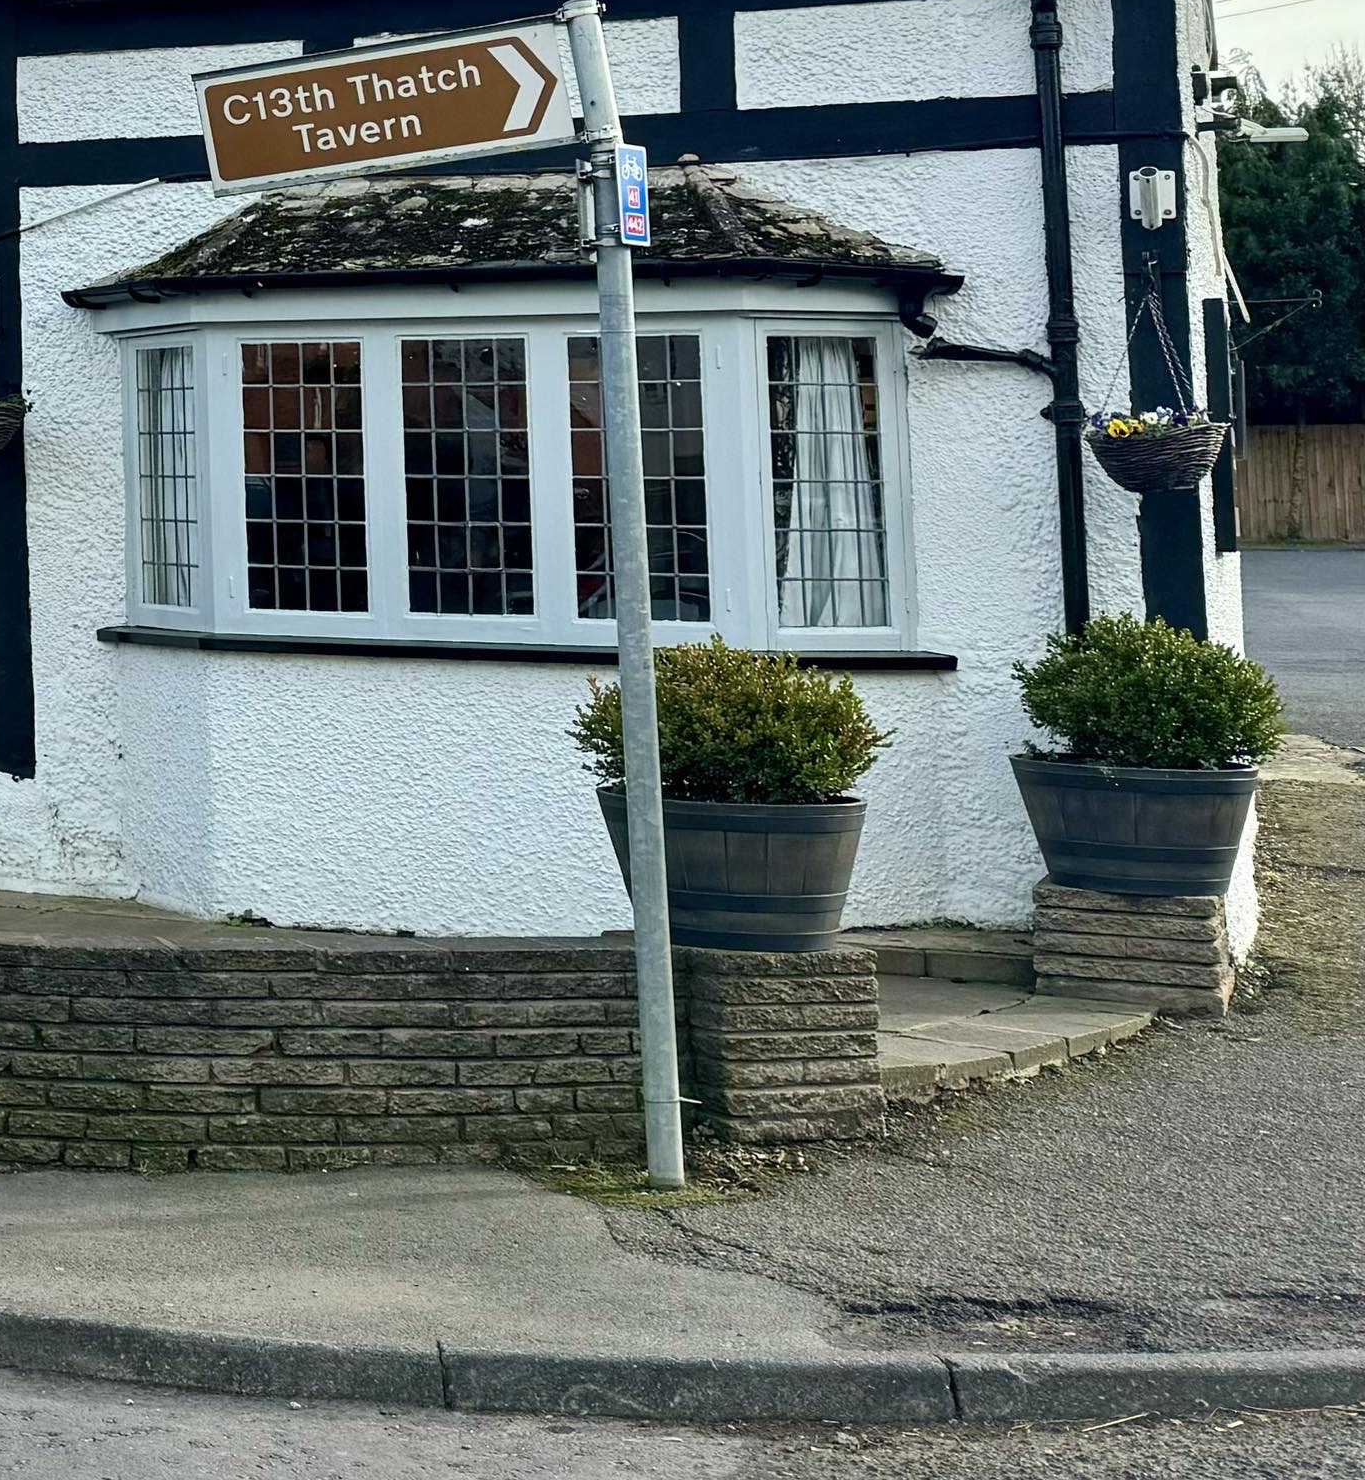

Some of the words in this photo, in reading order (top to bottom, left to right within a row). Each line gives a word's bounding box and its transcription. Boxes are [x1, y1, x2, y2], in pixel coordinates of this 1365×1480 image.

[222, 82, 336, 126] C13th
[346, 58, 482, 105] Thatch
[291, 113, 423, 153] Tavern
[628, 216, 643, 231] 442
